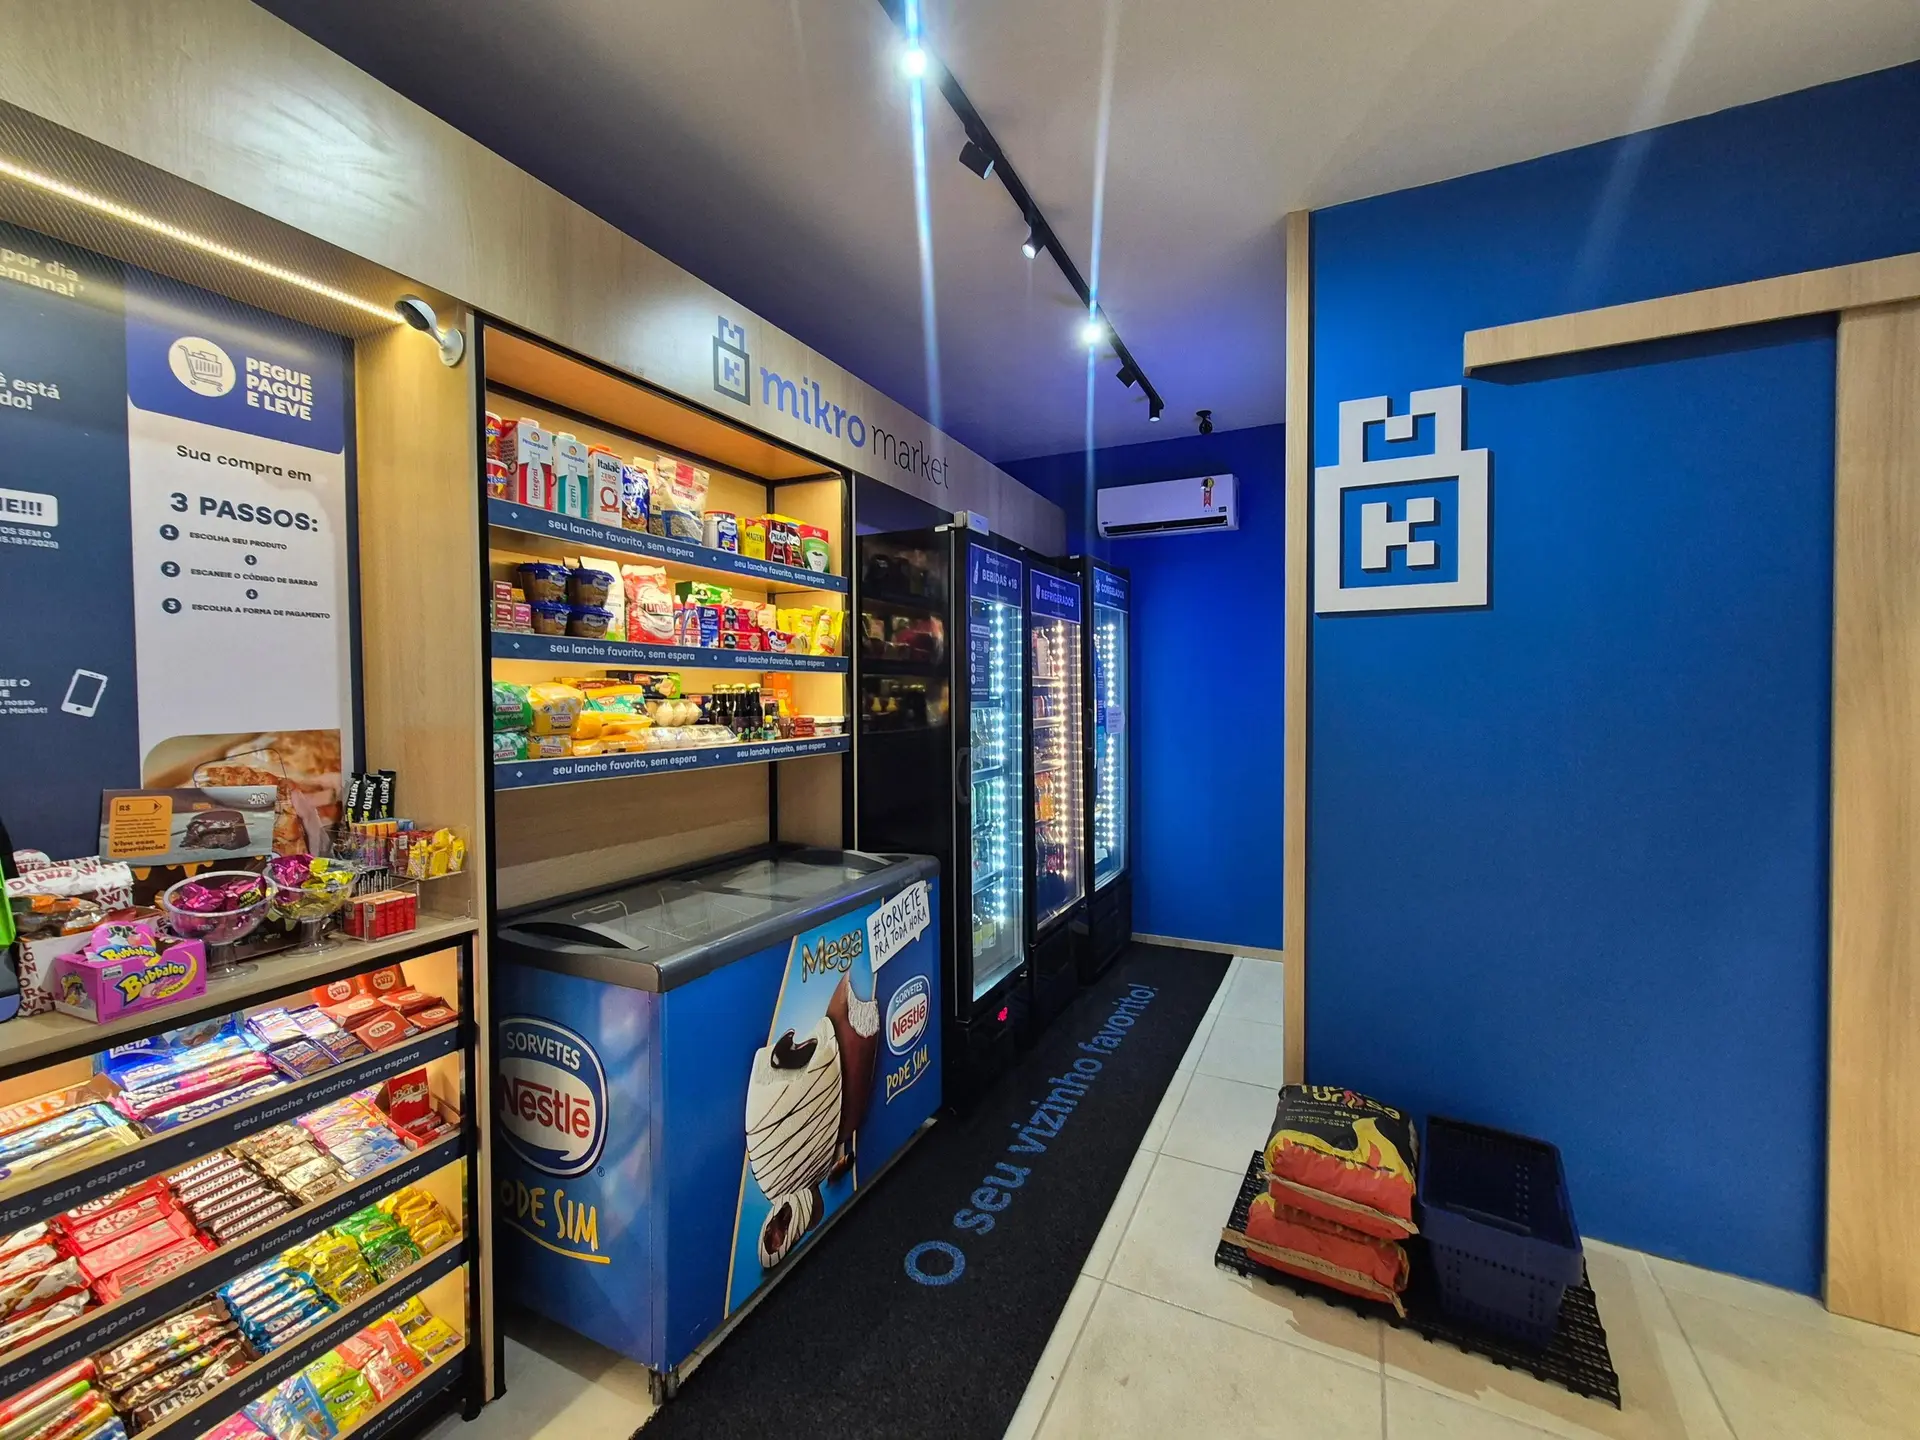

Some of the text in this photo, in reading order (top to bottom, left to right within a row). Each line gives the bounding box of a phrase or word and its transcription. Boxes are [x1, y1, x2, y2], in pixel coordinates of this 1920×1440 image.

[1, 247, 79, 282] por dia
[12, 375, 60, 400] está
[246, 356, 312, 389] PEGUE
[246, 374, 313, 406] PAGUE
[247, 390, 312, 421] E LEVE
[759, 366, 949, 489] mikro market
[176, 444, 313, 482] Sua compra em
[597, 458, 620, 474] Italac
[0, 497, 42, 516] E!!!
[170, 492, 318, 533] 3 PASSOS:
[189, 532, 230, 544] ESCOLHA
[232, 537, 248, 546] SEU
[250, 539, 287, 550] PRODUTO
[548, 519, 694, 558] seu lanche favorito, sem espera
[190, 568, 233, 579] ESCANEIE
[234, 572, 241, 580] O
[243, 571, 275, 583] CÓDIGO
[289, 579, 318, 587] BARRAS
[734, 559, 825, 584] seu lanche favorito, sem espera
[982, 568, 1007, 588] BEBIDAS
[191, 604, 232, 614] ESCOLHA
[243, 607, 272, 615] FORMA
[285, 610, 330, 620] PAGAMENTO
[1040, 589, 1074, 608] REFRIGERADOS
[550, 643, 695, 661] seu lanche favorito, sem espera
[735, 654, 825, 668] seu lanche favorito, sem espera
[553, 754, 697, 776] seu lanche favorito, sem espera
[737, 742, 826, 757] seu lanche favorito, sem espera
[873, 887, 922, 940] #SORVETE
[874, 907, 927, 962] PRA TODA HORA
[802, 928, 864, 983] Mega
[119, 963, 186, 1004] Bubbaloo
[895, 981, 924, 1008] SORVETES
[109, 1037, 151, 1058] LACTA
[507, 1031, 581, 1071] SORVETES
[886, 1044, 928, 1098] PODE SIM
[233, 1051, 421, 1131] seu lanche favorito, sem espera
[903, 982, 1160, 1286] O seu vizinho favorito!
[42, 1185, 82, 1206] sem
[86, 1158, 147, 1190] espera
[234, 1164, 421, 1267] seu lanche favorito, sem espera
[557, 1189, 599, 1253] SIM
[41, 1343, 82, 1367] sem
[86, 1306, 147, 1343] espera
[239, 1275, 424, 1398] seu lanche favorito, sem espera
[362, 1390, 424, 1440] sem espera
